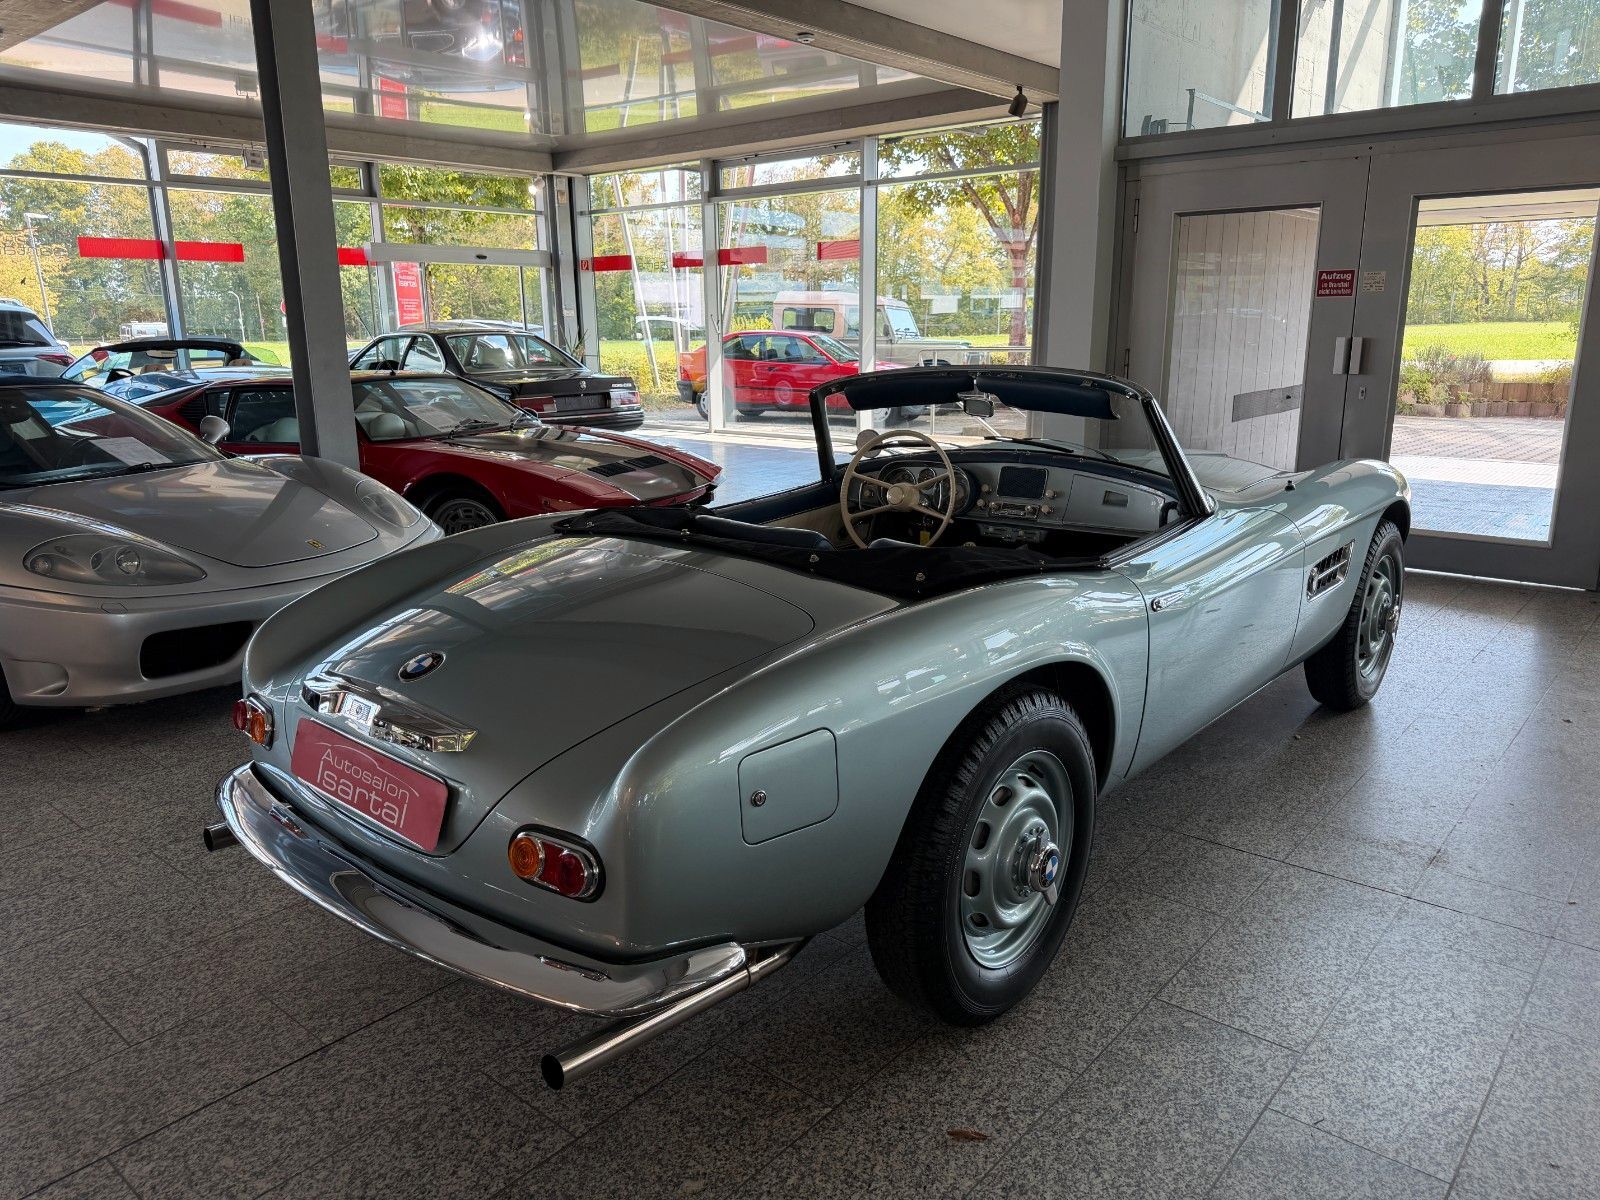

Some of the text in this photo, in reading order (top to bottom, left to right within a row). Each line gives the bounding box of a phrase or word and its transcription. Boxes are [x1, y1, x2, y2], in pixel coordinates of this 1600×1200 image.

[1321, 272, 1352, 280] Aufzug
[316, 760, 408, 829] Isartal
[321, 748, 409, 803] Autosalon
